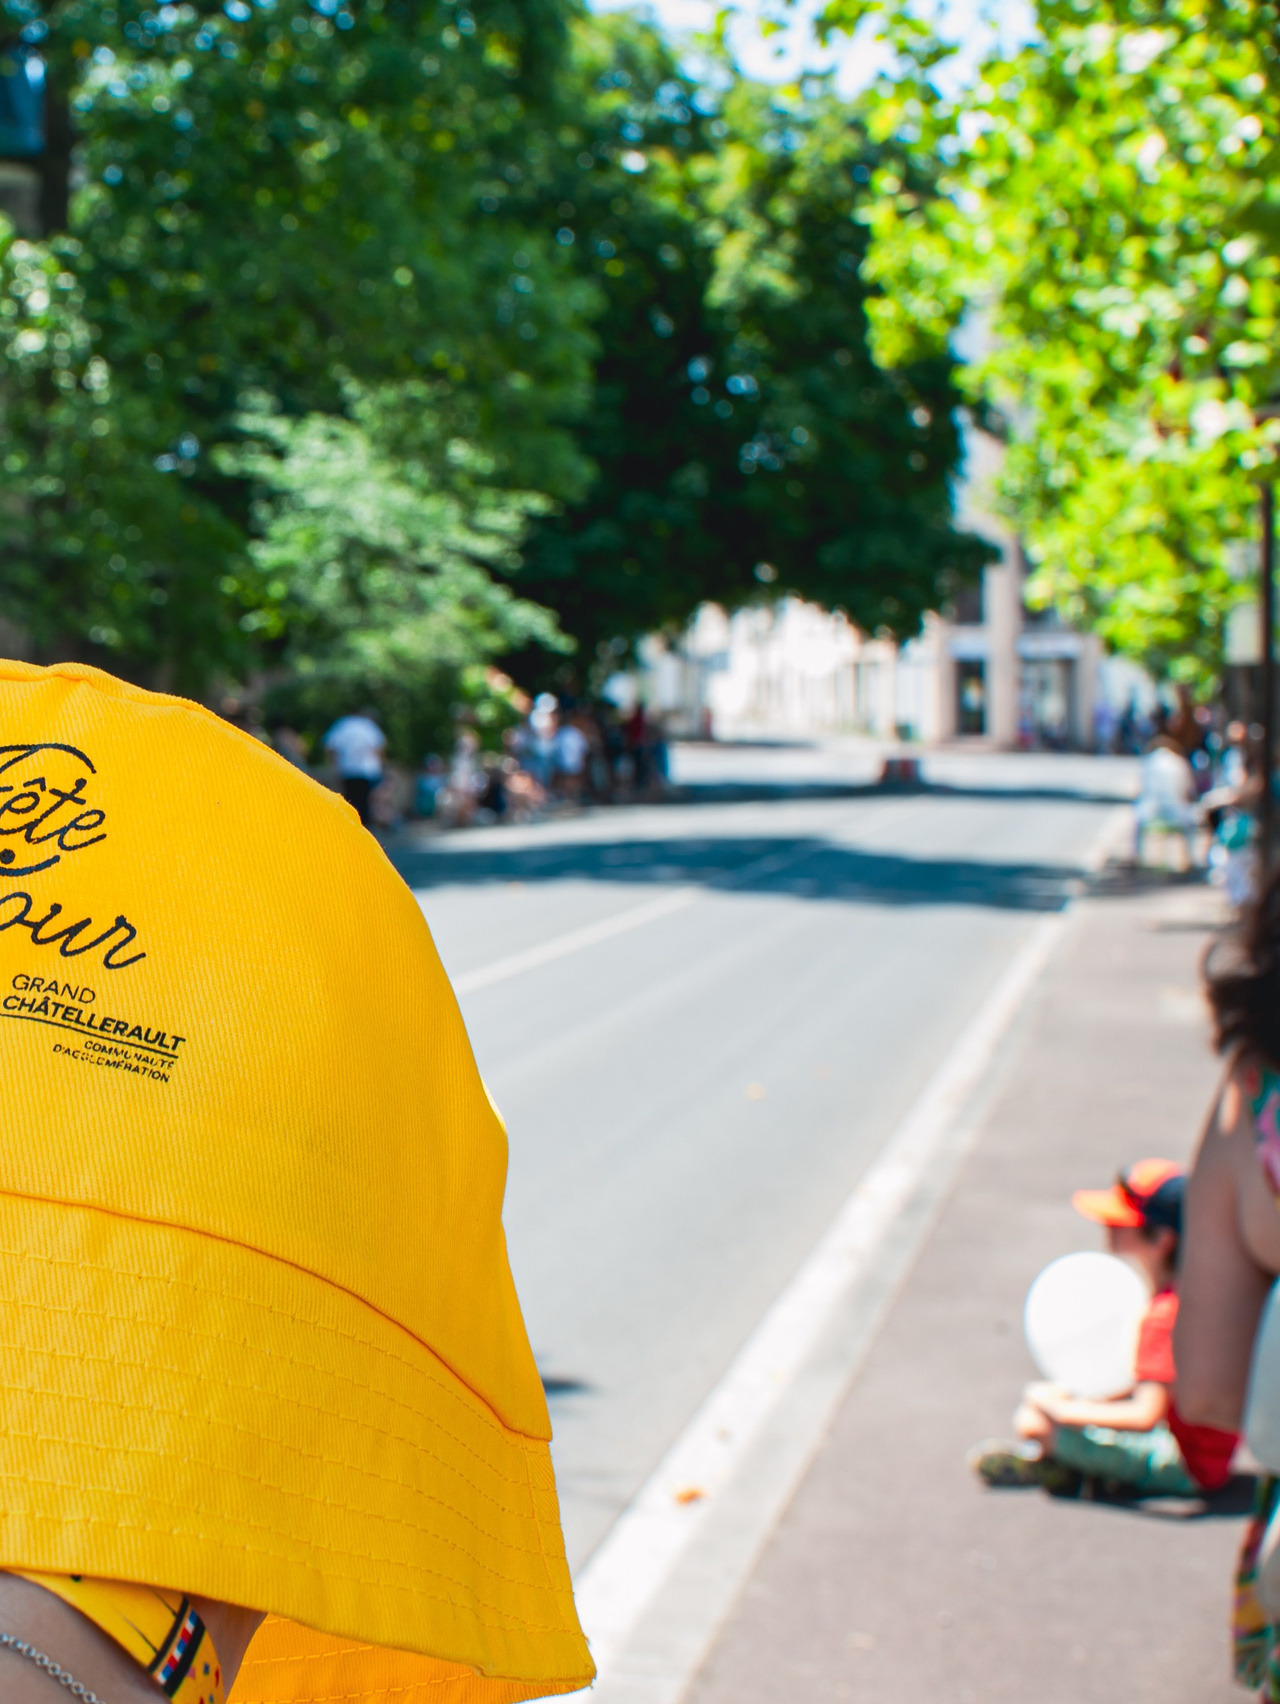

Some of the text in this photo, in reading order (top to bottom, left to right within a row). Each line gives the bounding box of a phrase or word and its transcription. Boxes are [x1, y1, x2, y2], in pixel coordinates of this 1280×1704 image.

[12, 973, 96, 1004] GRAND
[2, 994, 187, 1051] CHÂTELLERAULT
[84, 1040, 175, 1070] COMMUNAUTÉ
